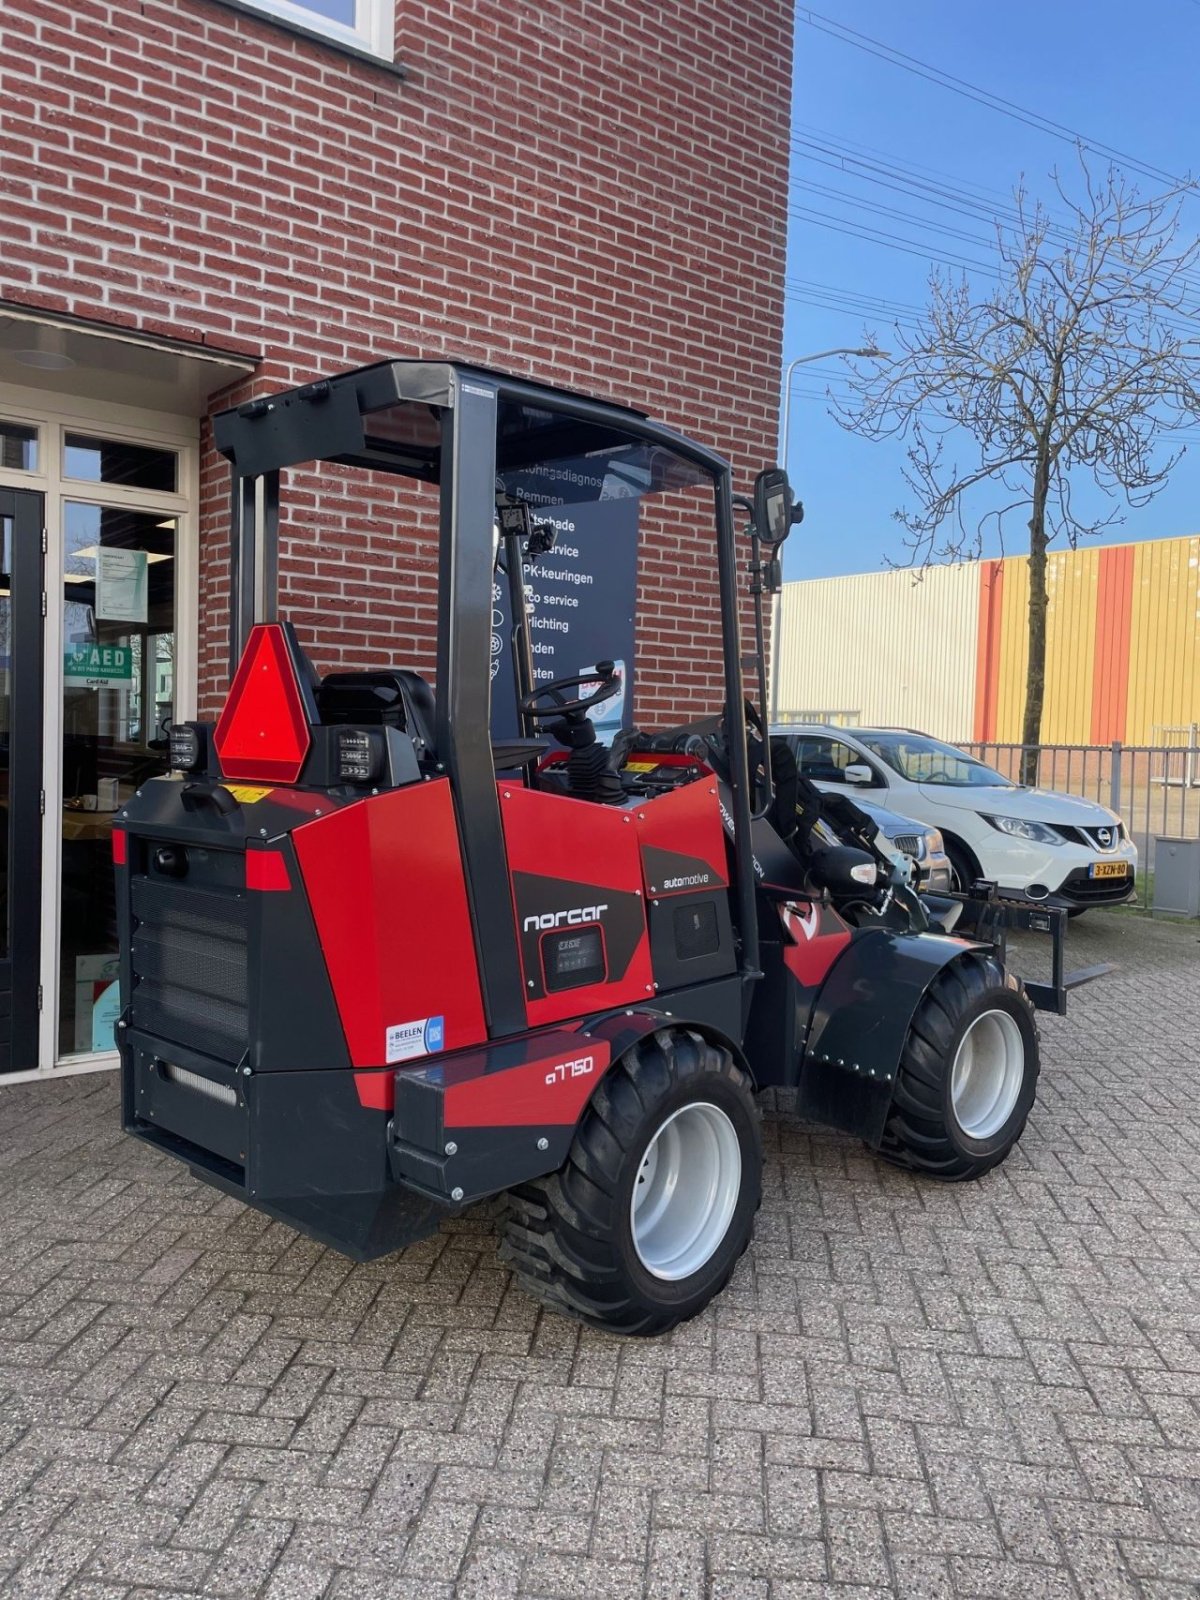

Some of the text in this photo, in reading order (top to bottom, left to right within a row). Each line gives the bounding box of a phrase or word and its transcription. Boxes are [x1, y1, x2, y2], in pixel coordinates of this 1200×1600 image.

[516, 487, 564, 505] Remmen
[531, 513, 575, 531] tschade
[523, 564, 593, 584] PK-keuringen
[543, 595, 579, 607] service
[90, 649, 124, 666] AED
[664, 873, 709, 889] automotive
[524, 904, 608, 932] norcar
[395, 1026, 422, 1040] BEELEN
[545, 1055, 594, 1085] a7750
